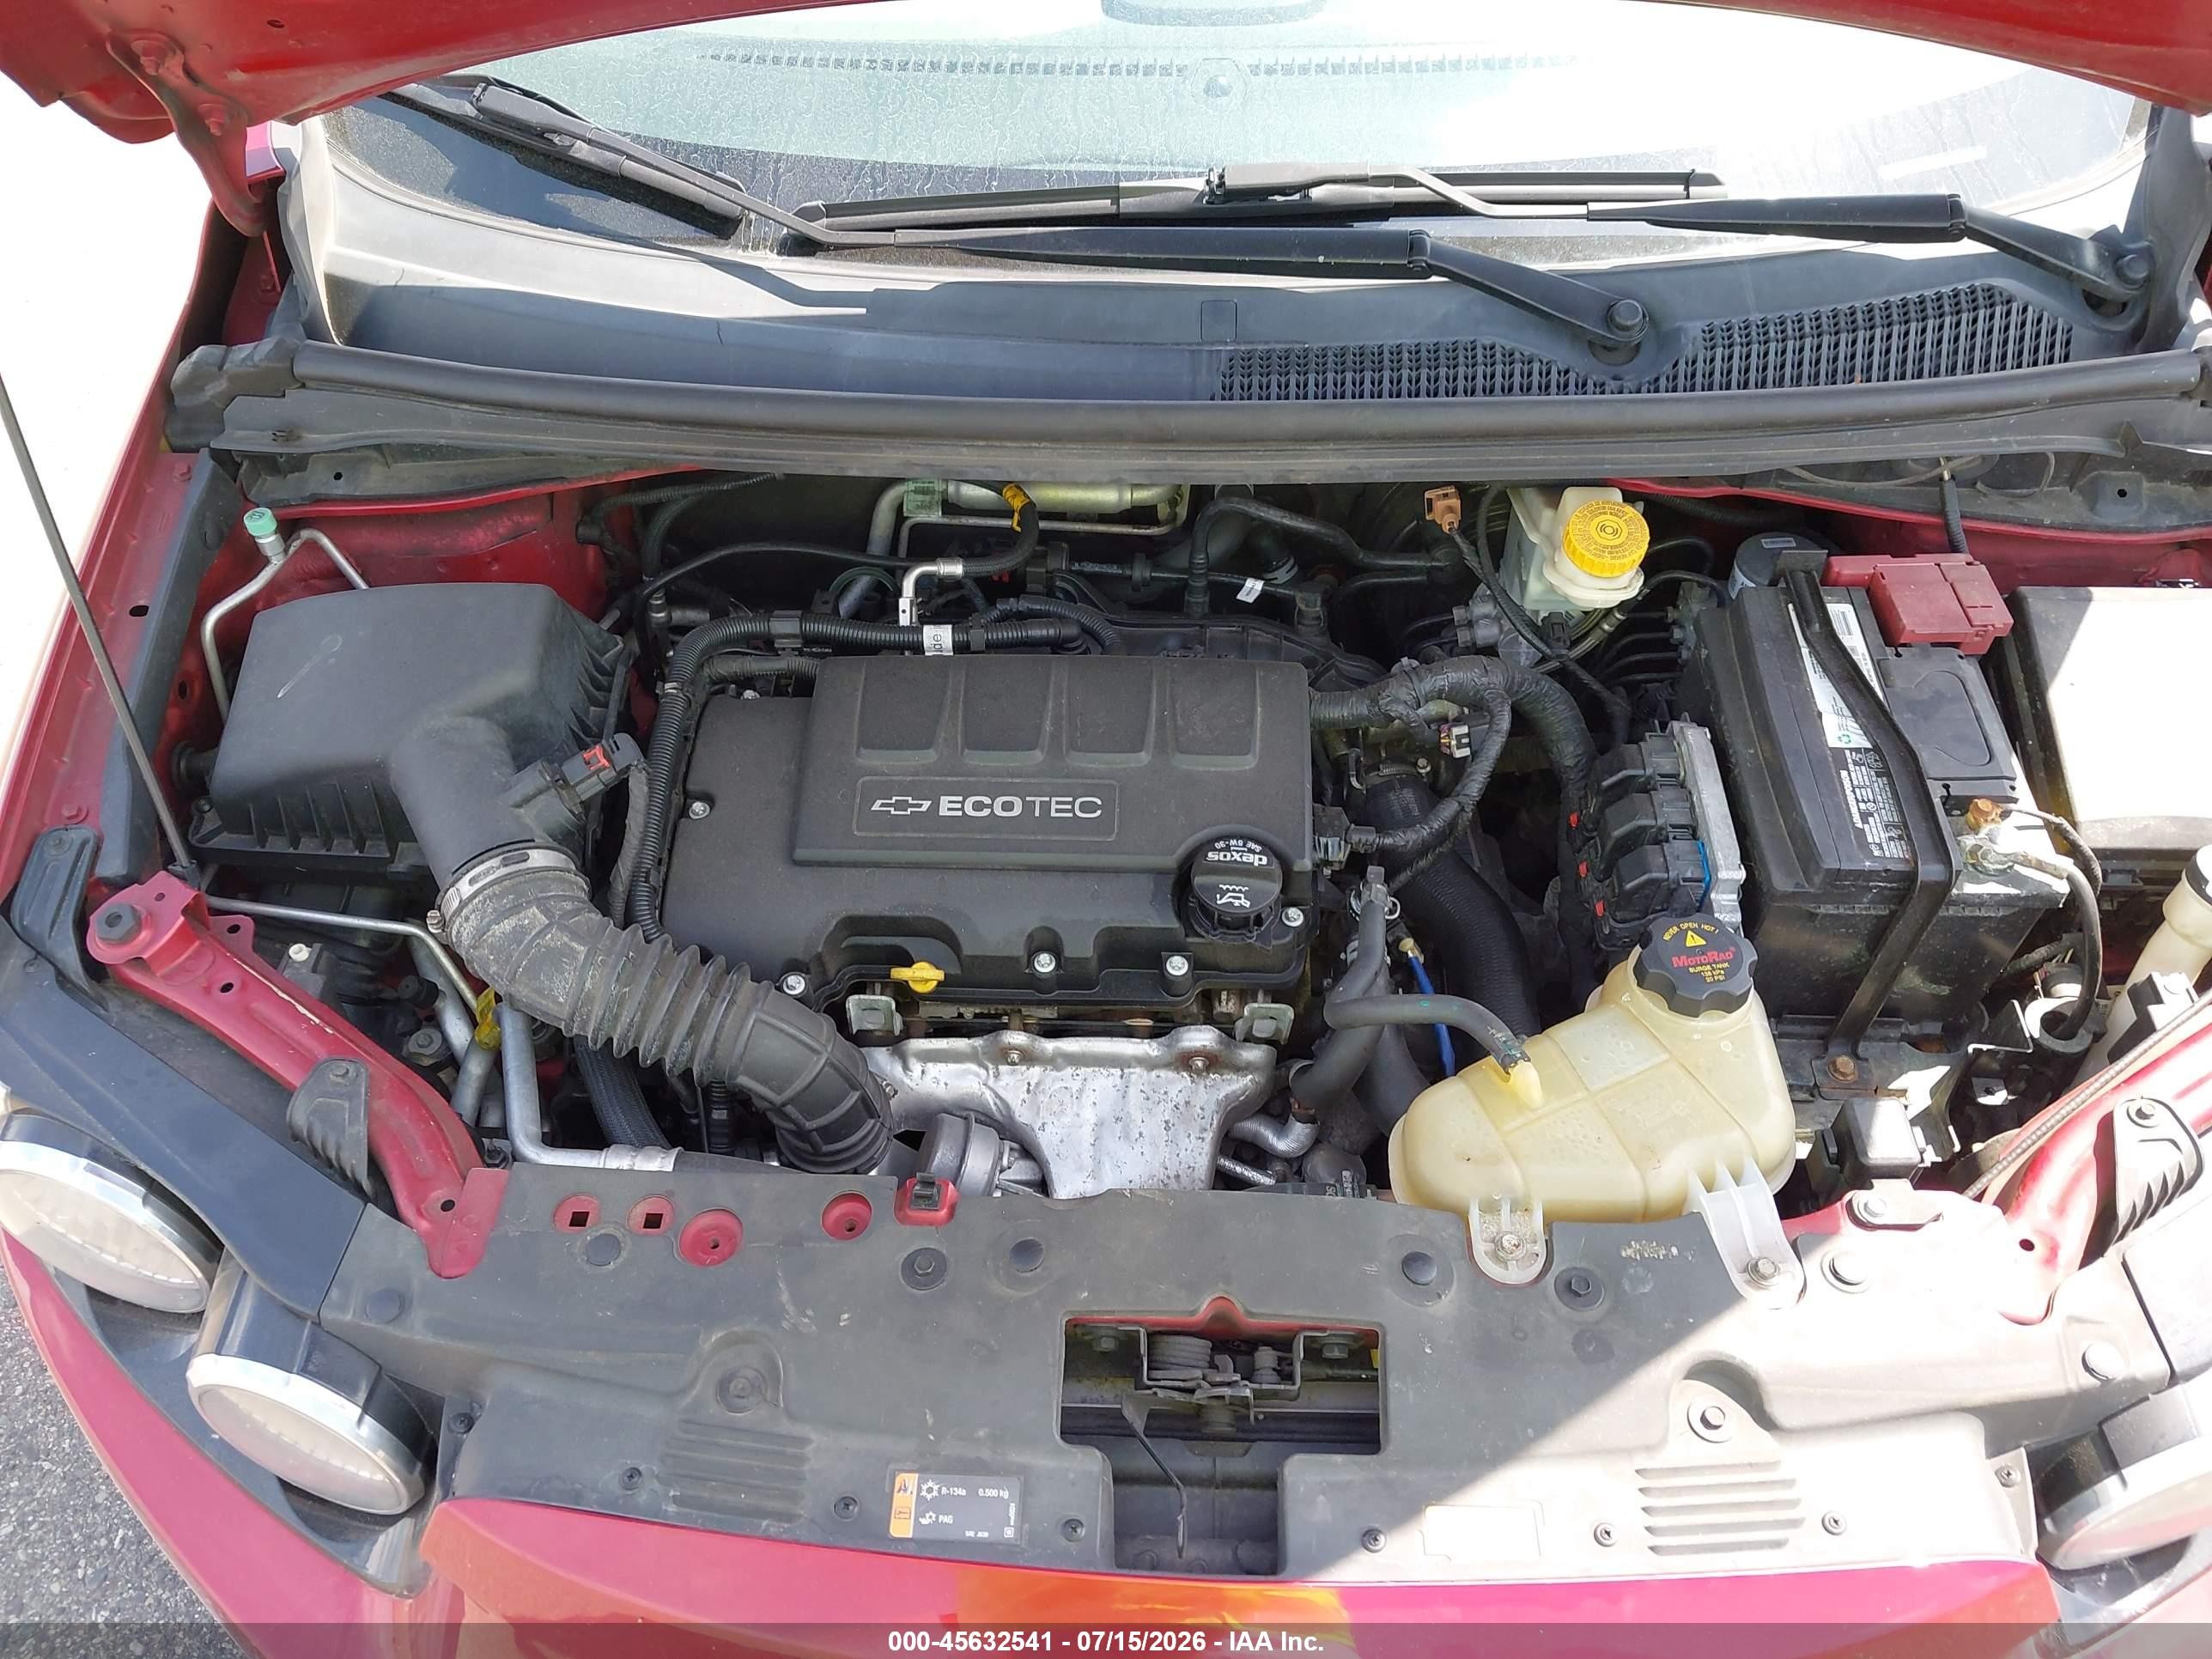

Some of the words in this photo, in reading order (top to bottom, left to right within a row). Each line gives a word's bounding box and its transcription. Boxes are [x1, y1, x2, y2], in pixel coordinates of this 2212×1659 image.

[939, 795, 1103, 818] ECOTEC
[1246, 841, 1262, 853] SAE
[1206, 851, 1268, 866] dexos
[1662, 924, 1680, 941] NEVER
[1680, 921, 1698, 930] OPEN
[1688, 964, 1712, 973] SURGE
[1711, 962, 1730, 970] TANK
[940, 1486, 967, 1497] R-134a
[977, 1487, 999, 1498] 0.500
[938, 1515, 954, 1524] PAG
